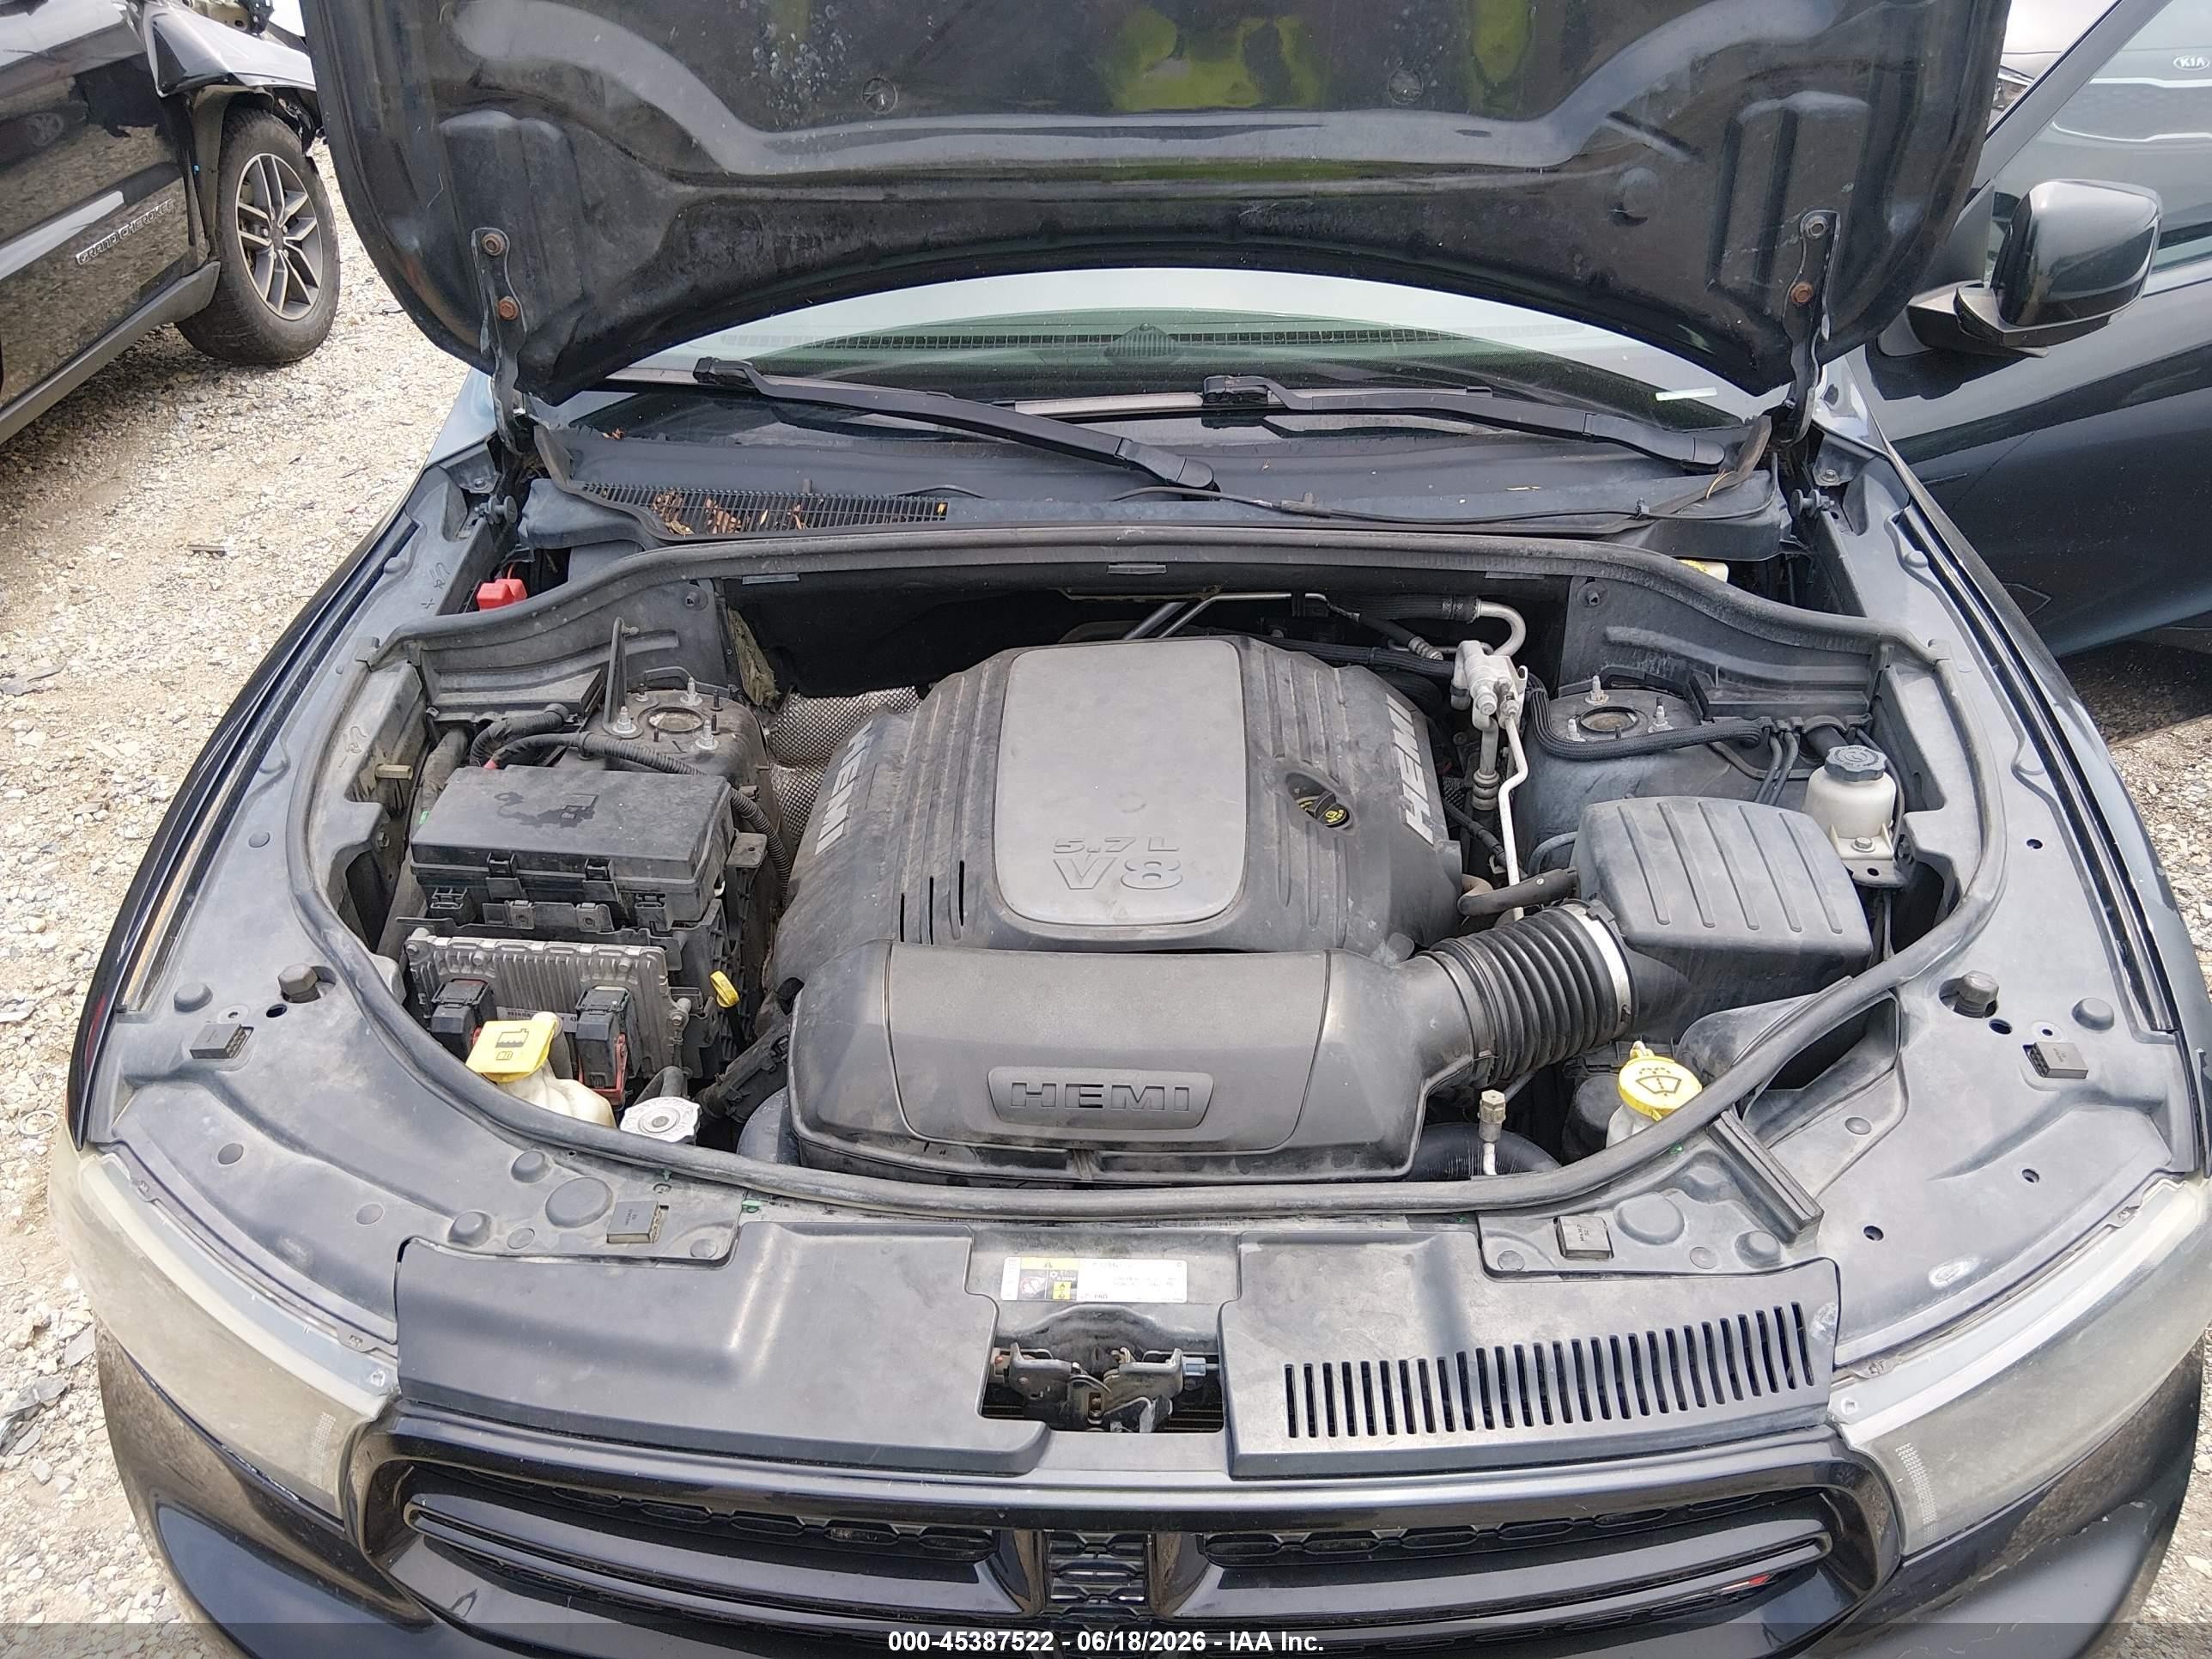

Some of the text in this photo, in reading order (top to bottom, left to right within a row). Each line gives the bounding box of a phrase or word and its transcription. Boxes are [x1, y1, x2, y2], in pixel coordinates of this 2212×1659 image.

[2179, 57, 2207, 68] KIA
[76, 230, 119, 265] GRAND
[1385, 692, 1435, 846] HEMI
[814, 719, 874, 856] HEMI
[1053, 858, 1183, 890] V8
[1010, 1082, 1190, 1112] HEMI
